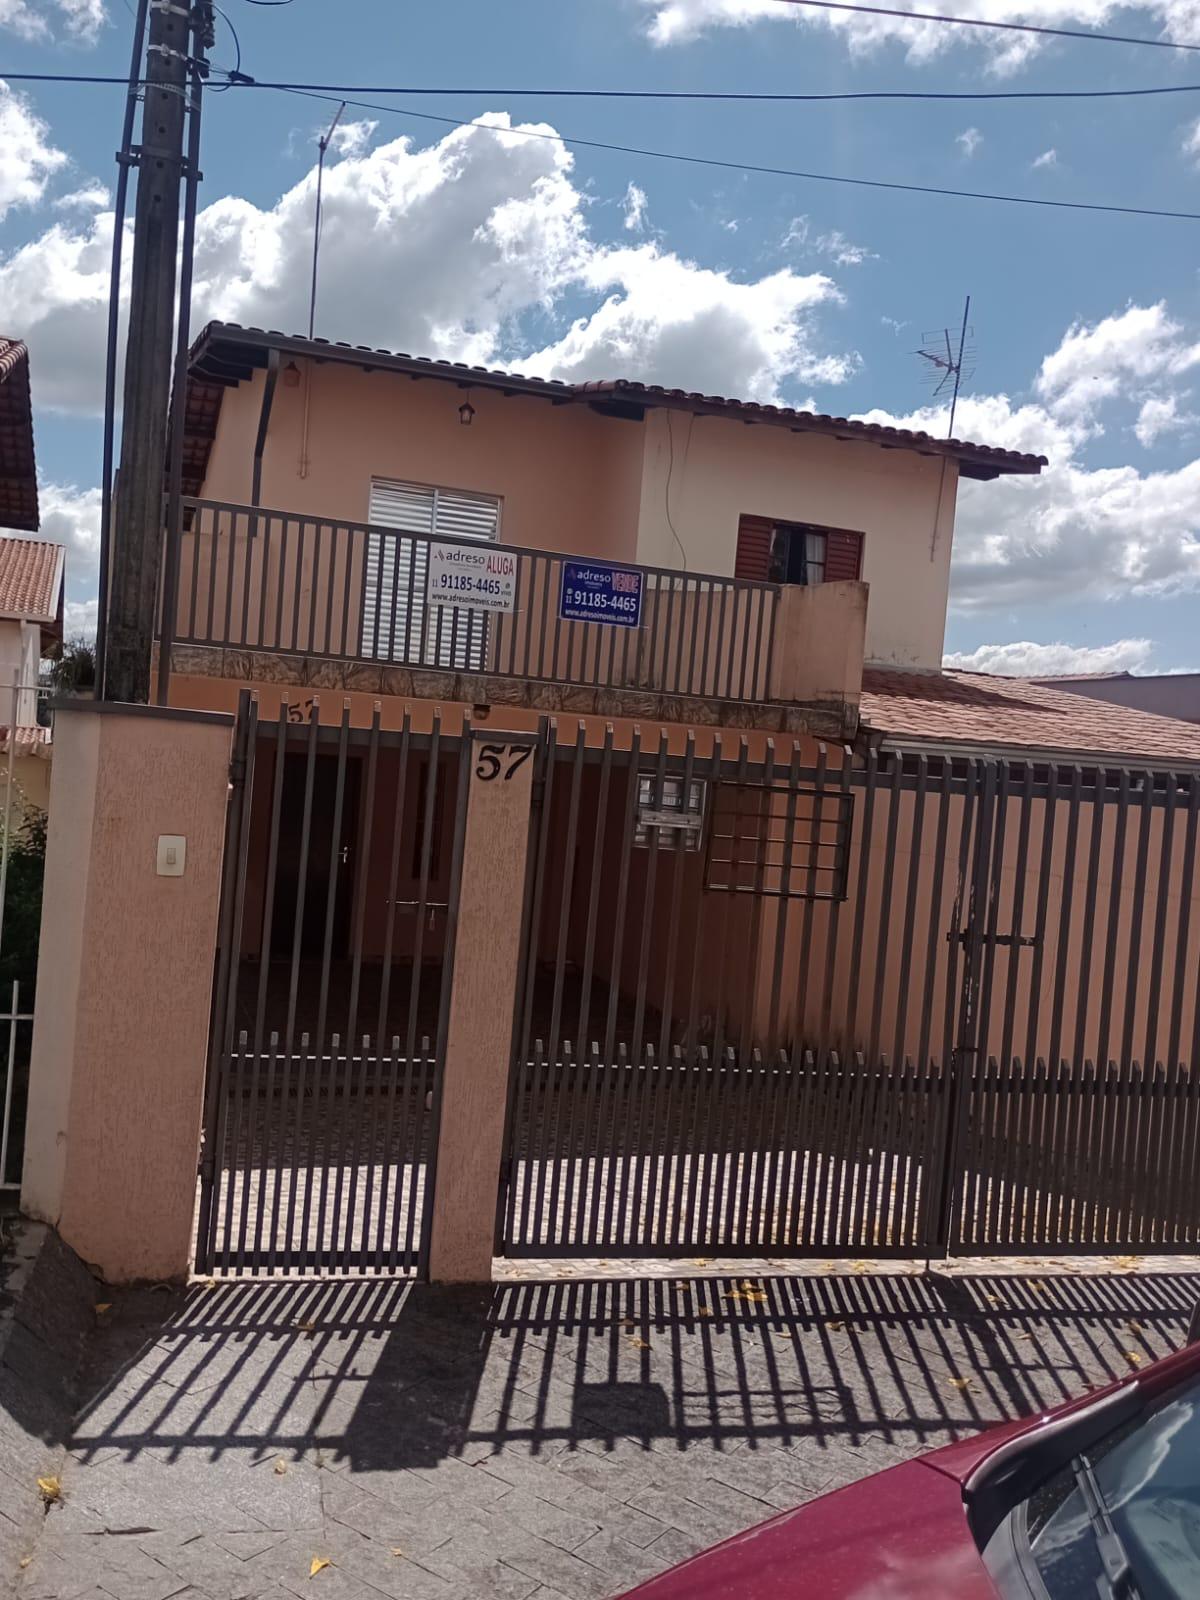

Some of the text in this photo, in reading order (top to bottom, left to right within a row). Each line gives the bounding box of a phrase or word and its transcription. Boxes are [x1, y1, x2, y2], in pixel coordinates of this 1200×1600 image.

[446, 550, 514, 576] adreso ALUGA
[441, 574, 501, 595] 91185-4465
[577, 569, 611, 583] adreso
[574, 590, 637, 612] 91185-4465
[476, 744, 533, 781] 57
